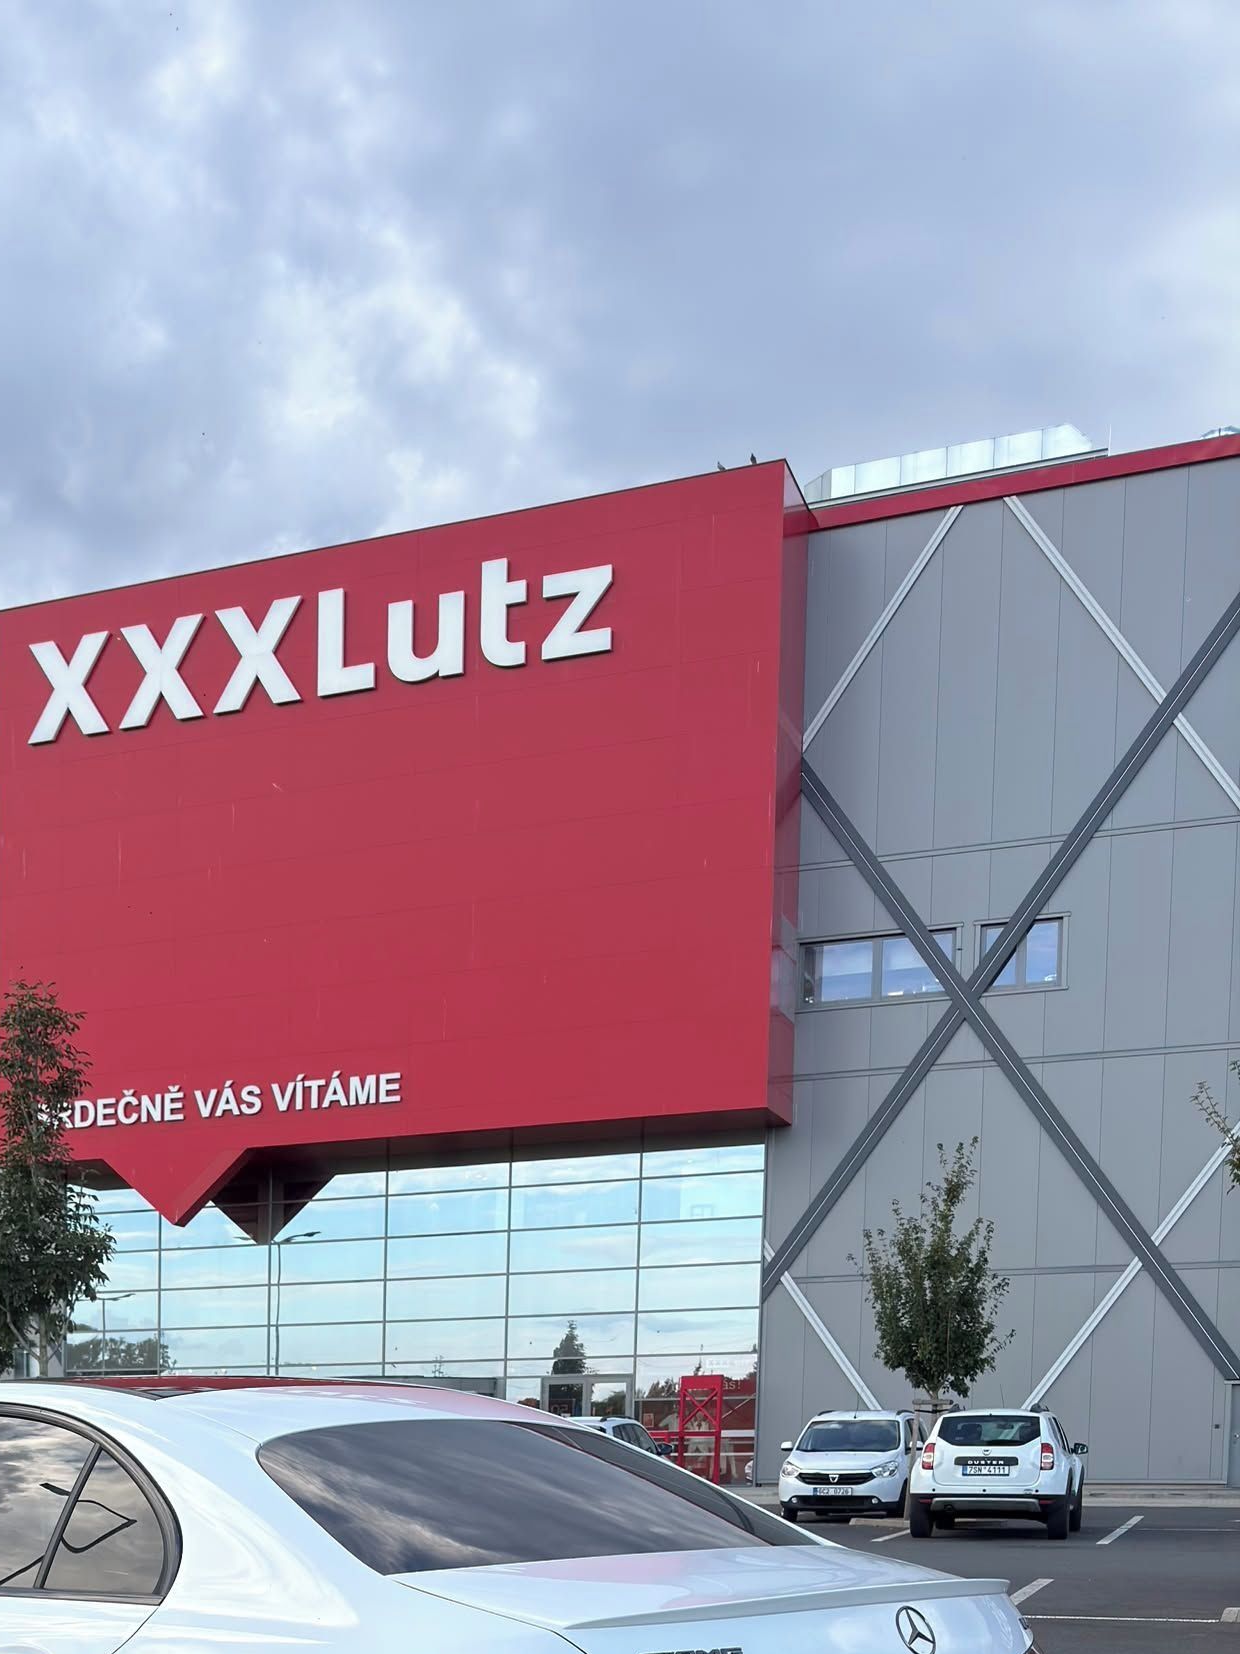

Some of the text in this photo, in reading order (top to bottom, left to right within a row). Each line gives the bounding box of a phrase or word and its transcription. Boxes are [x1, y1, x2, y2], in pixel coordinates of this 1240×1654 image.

[28, 557, 613, 745] XXXLutz
[194, 1080, 263, 1119] VÁS
[271, 1071, 401, 1112] VÍTÁME
[968, 1466, 1006, 1474] 7SN 4111
